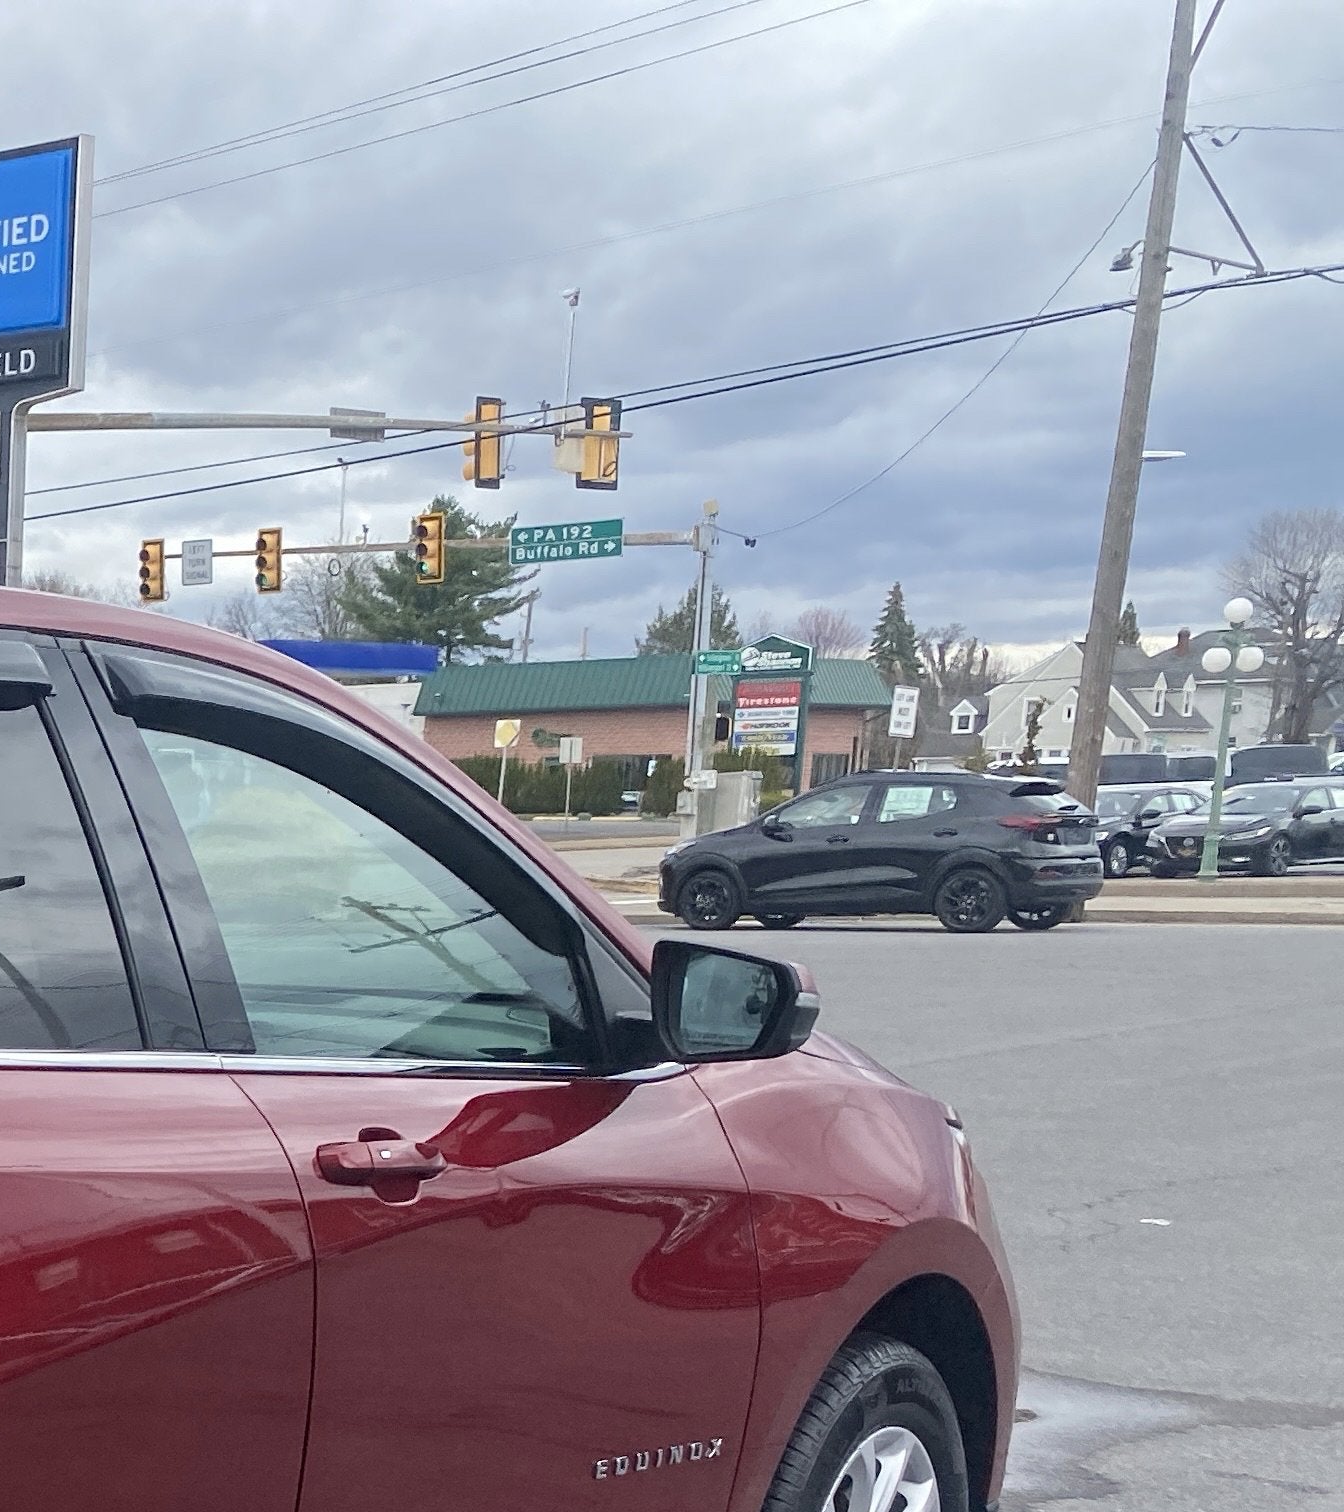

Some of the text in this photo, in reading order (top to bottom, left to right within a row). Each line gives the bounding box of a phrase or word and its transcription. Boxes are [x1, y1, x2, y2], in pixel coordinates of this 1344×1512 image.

[533, 525, 593, 543] PA 192
[515, 541, 599, 561] Buffalo Rd
[737, 696, 798, 708] Firestone
[595, 1438, 723, 1480] EQUINOX
